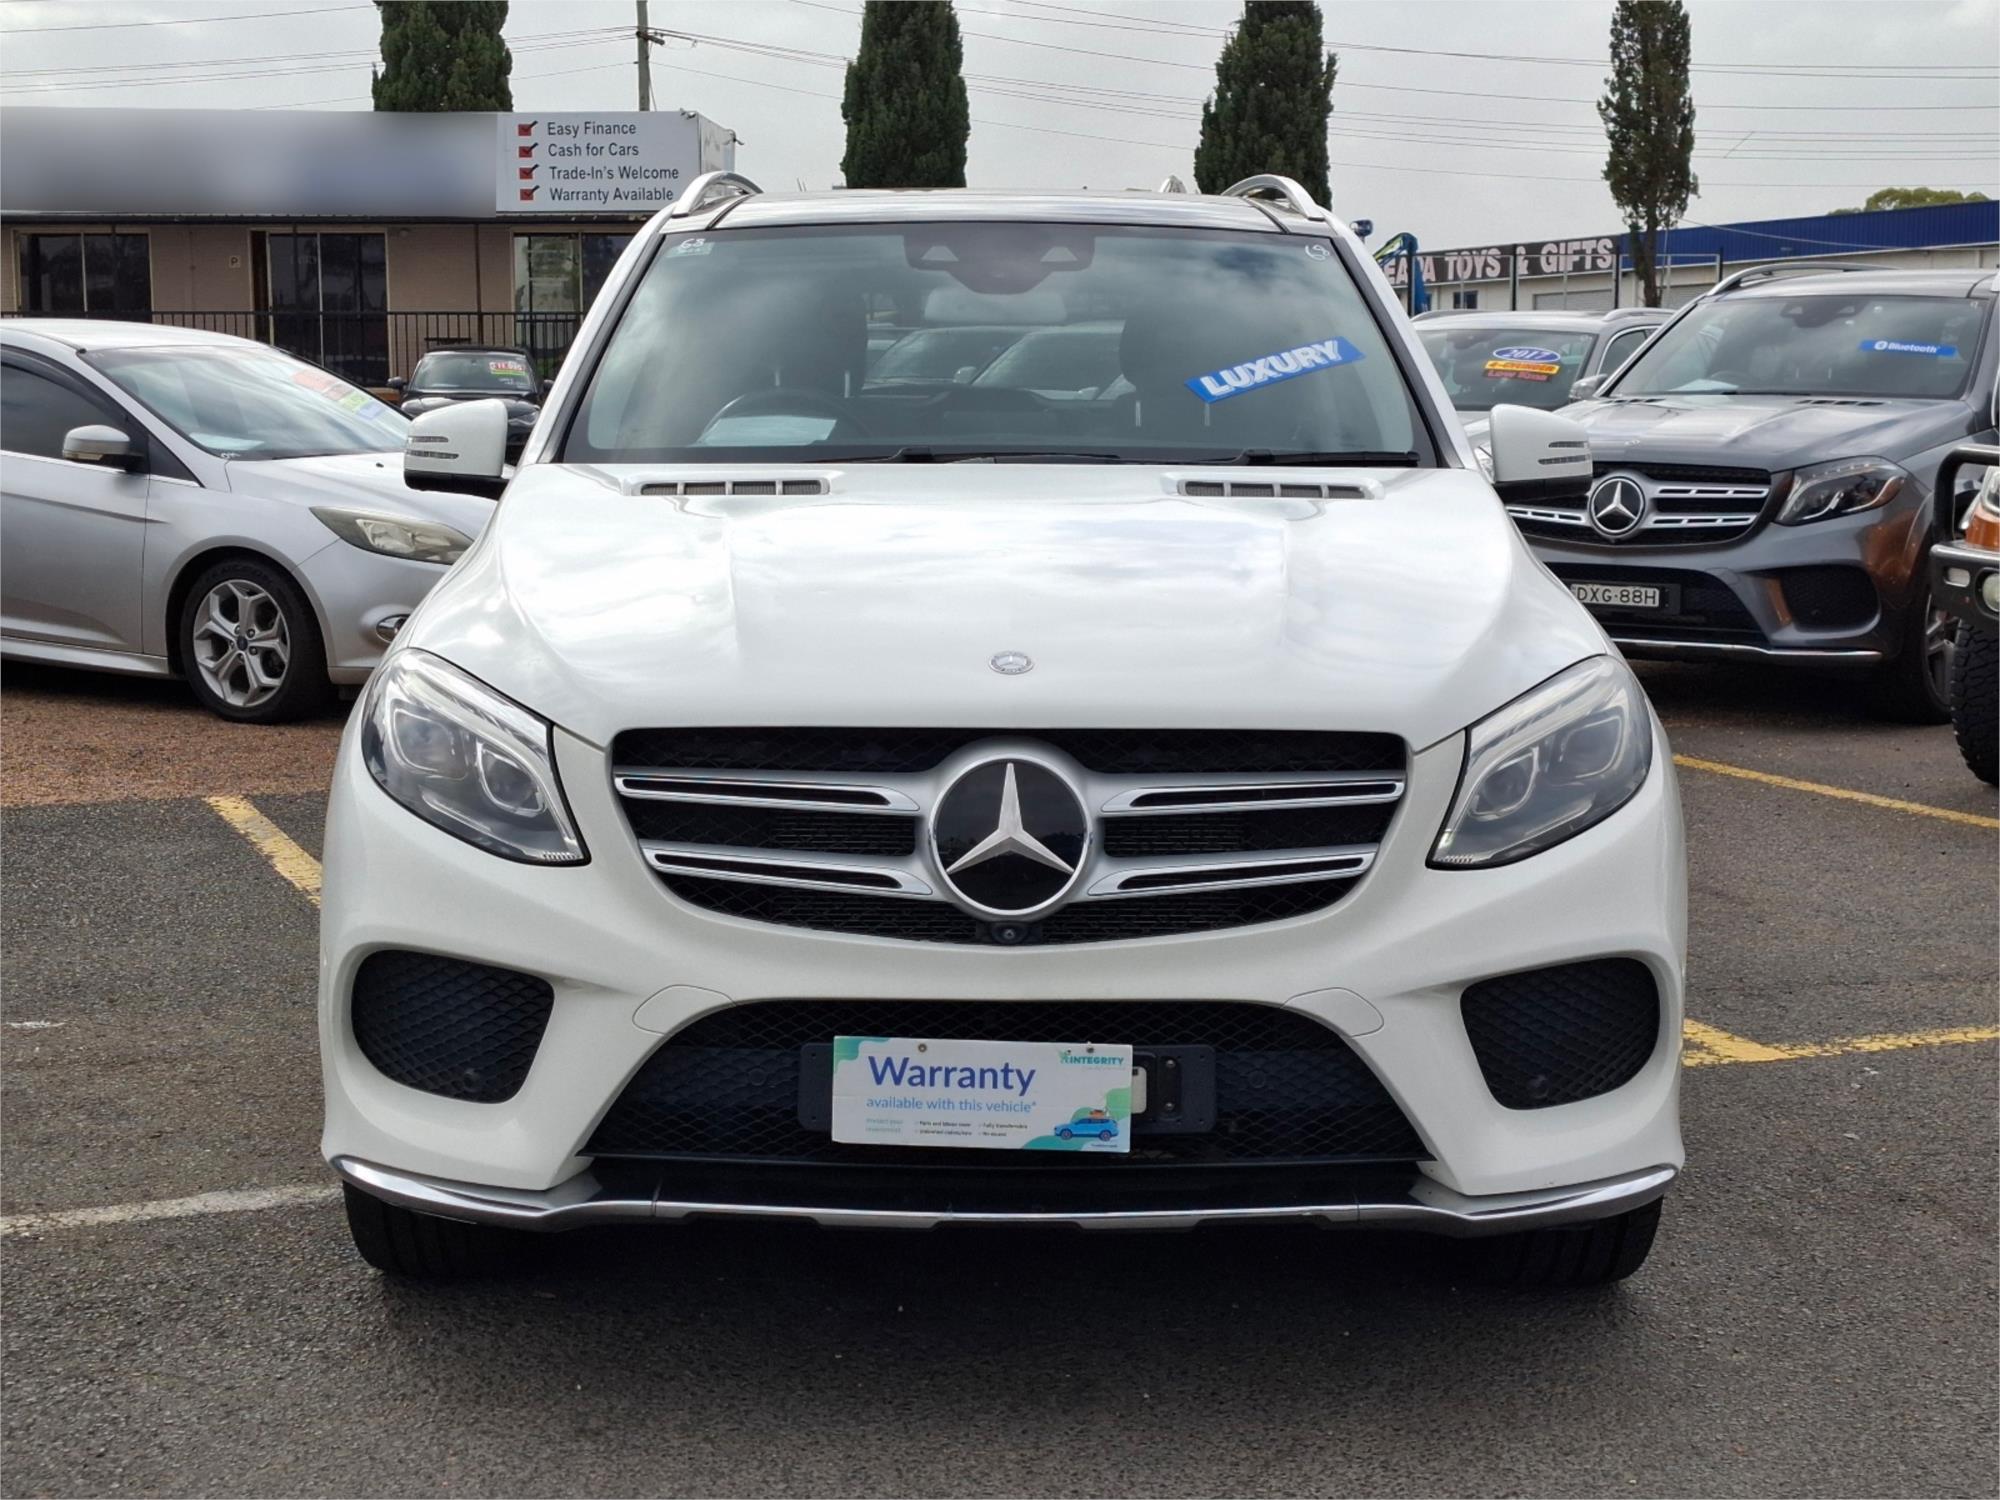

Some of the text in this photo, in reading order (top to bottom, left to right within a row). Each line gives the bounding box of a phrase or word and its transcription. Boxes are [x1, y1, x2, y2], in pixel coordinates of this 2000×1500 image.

[547, 121, 637, 138] Easy Finance
[548, 142, 640, 157] Cash for Cars
[549, 166, 679, 180] Trade-In's Welcome
[550, 187, 674, 204] Warranty Available
[1444, 248, 1501, 280] TOYS
[1516, 245, 1529, 275] &
[1540, 238, 1614, 273] GIFTS
[1502, 349, 1551, 360] 2017
[1887, 342, 1937, 354] Bluetooth
[1200, 339, 1343, 396] LUXURY
[1068, 1055, 1125, 1067] INTEGRITY
[867, 1055, 1036, 1097] Warranty
[866, 1096, 924, 1110] available
[926, 1098, 956, 1111] with
[958, 1099, 983, 1112] this
